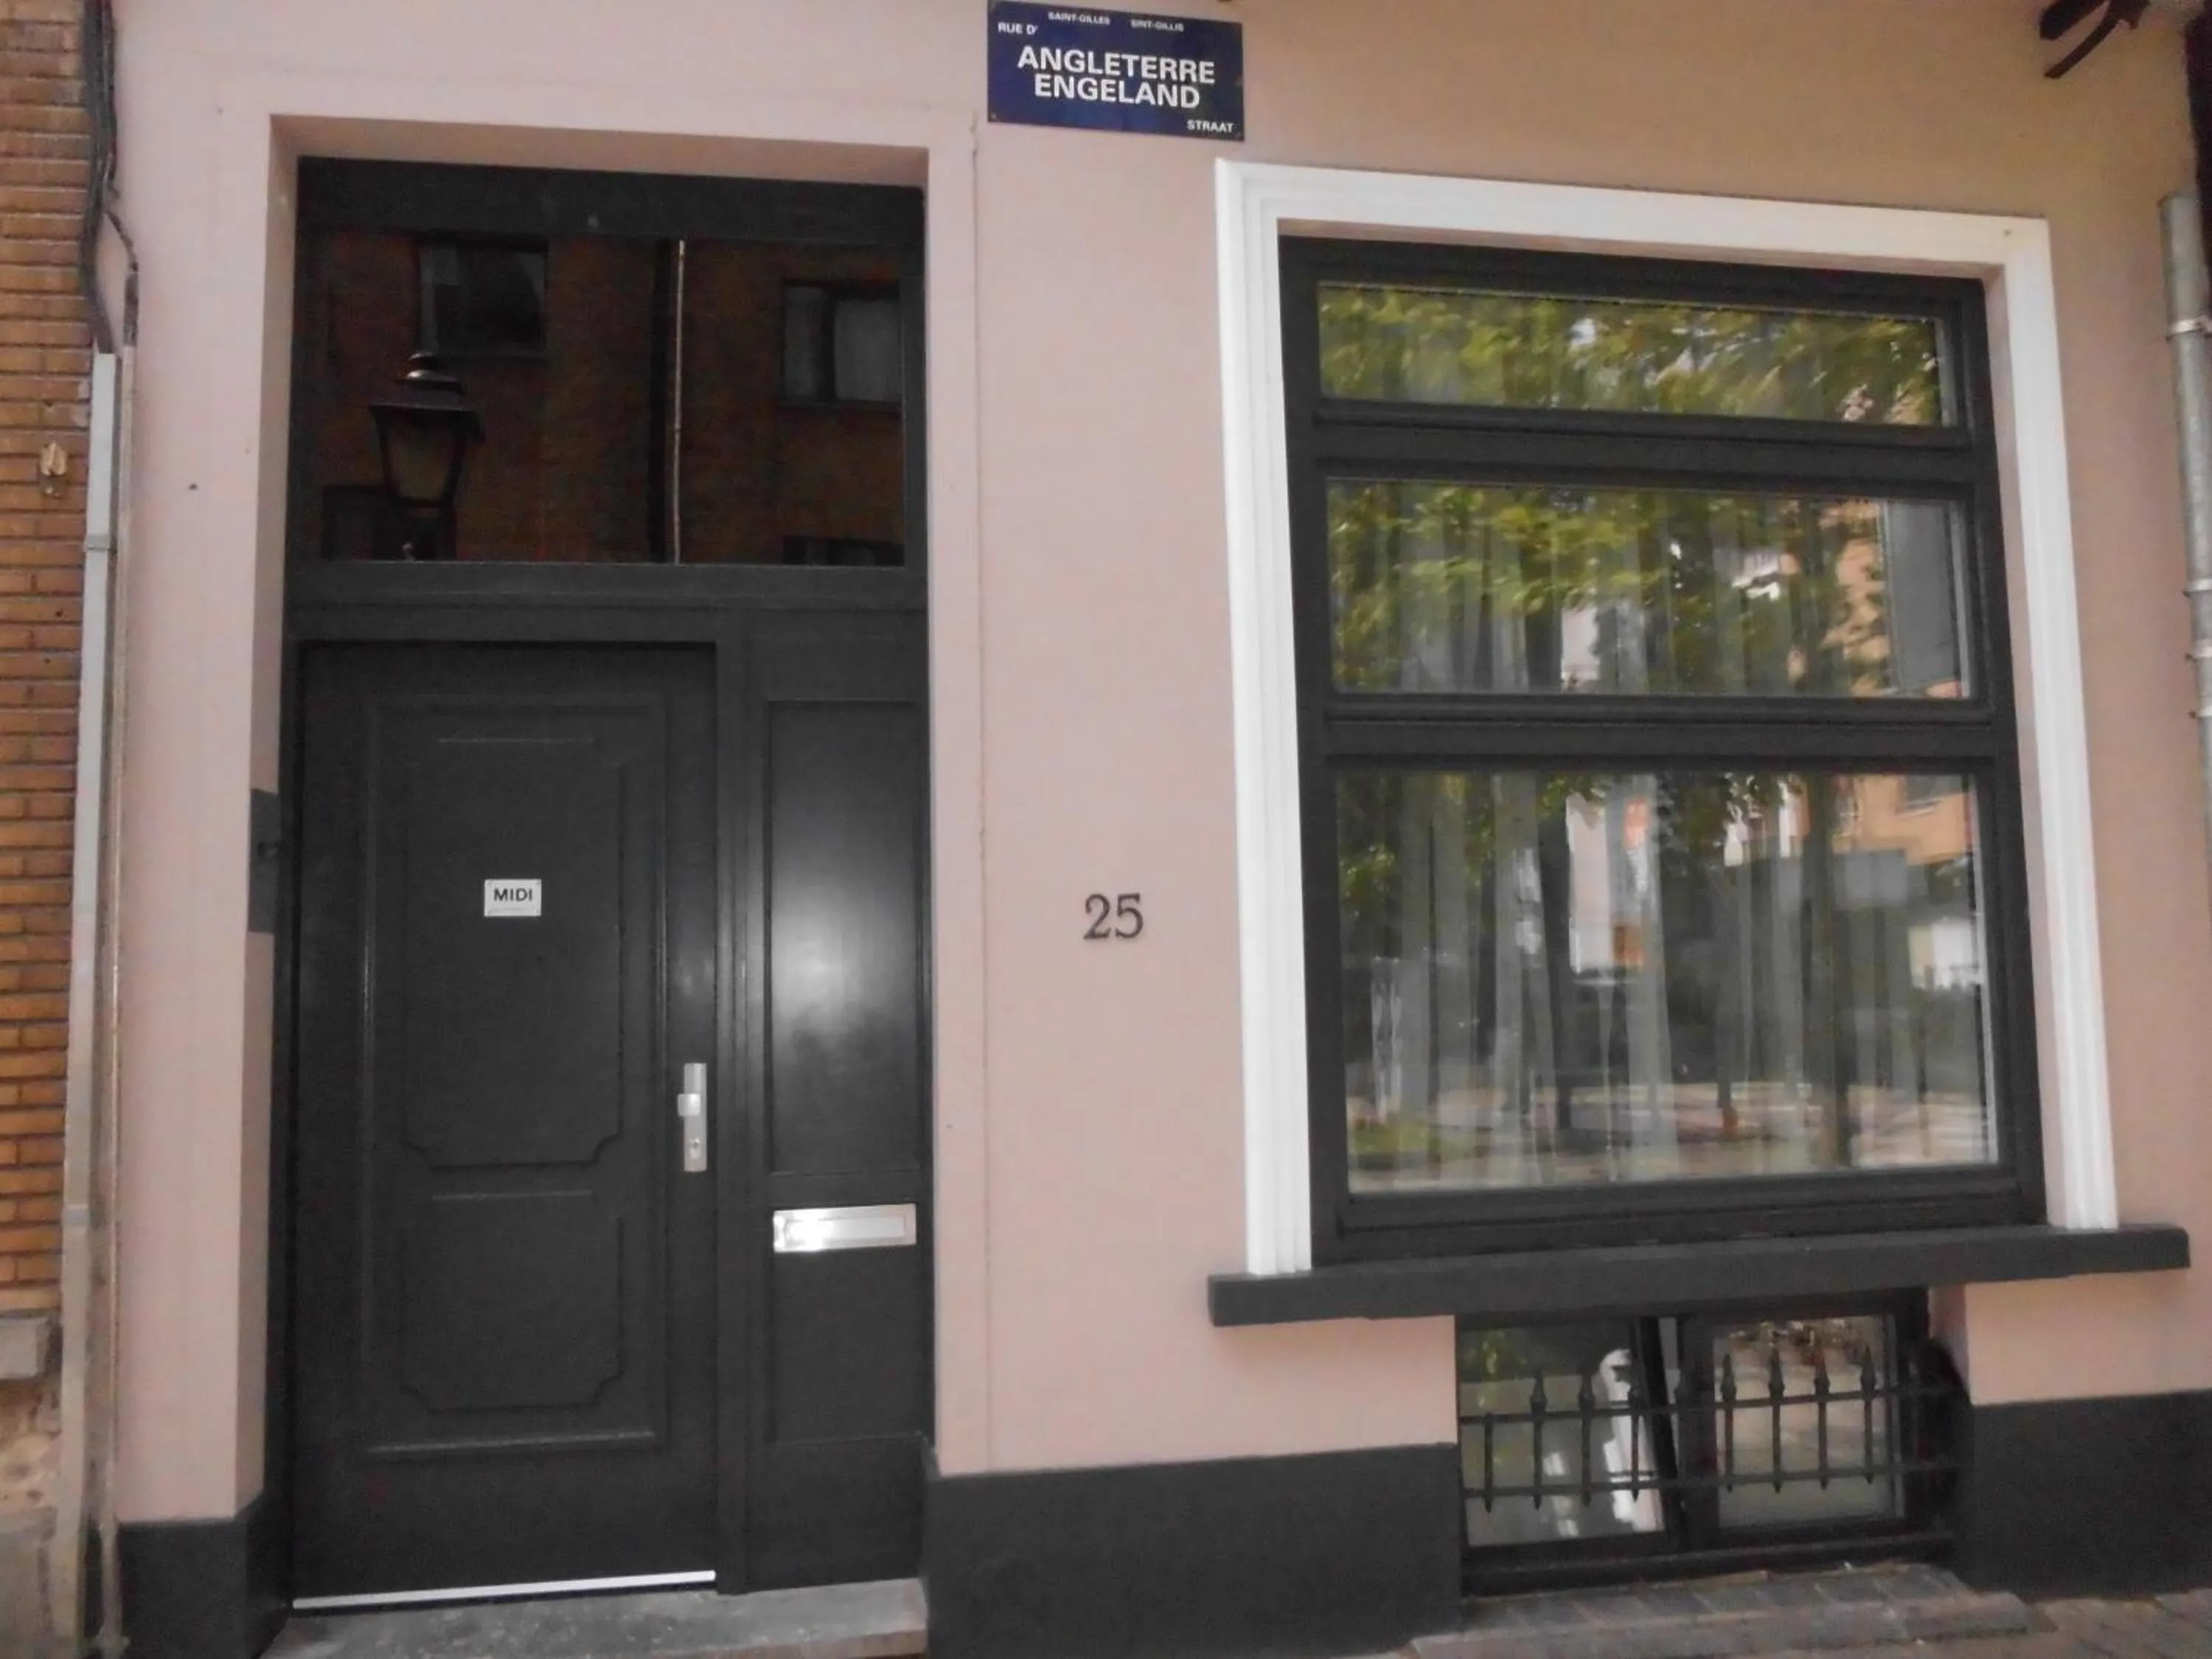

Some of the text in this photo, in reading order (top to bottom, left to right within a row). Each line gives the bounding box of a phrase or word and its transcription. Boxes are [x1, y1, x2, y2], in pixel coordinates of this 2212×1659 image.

[998, 22, 1023, 35] RUE
[1048, 11, 1184, 32] SAINT-GILLES SINT-GILLIS
[1018, 46, 1215, 84] ANGLETERRE
[1034, 74, 1200, 108] ENGELAND
[1187, 119, 1234, 133] STRAAT
[493, 887, 532, 902] MIDI
[1083, 892, 1144, 940] 25
